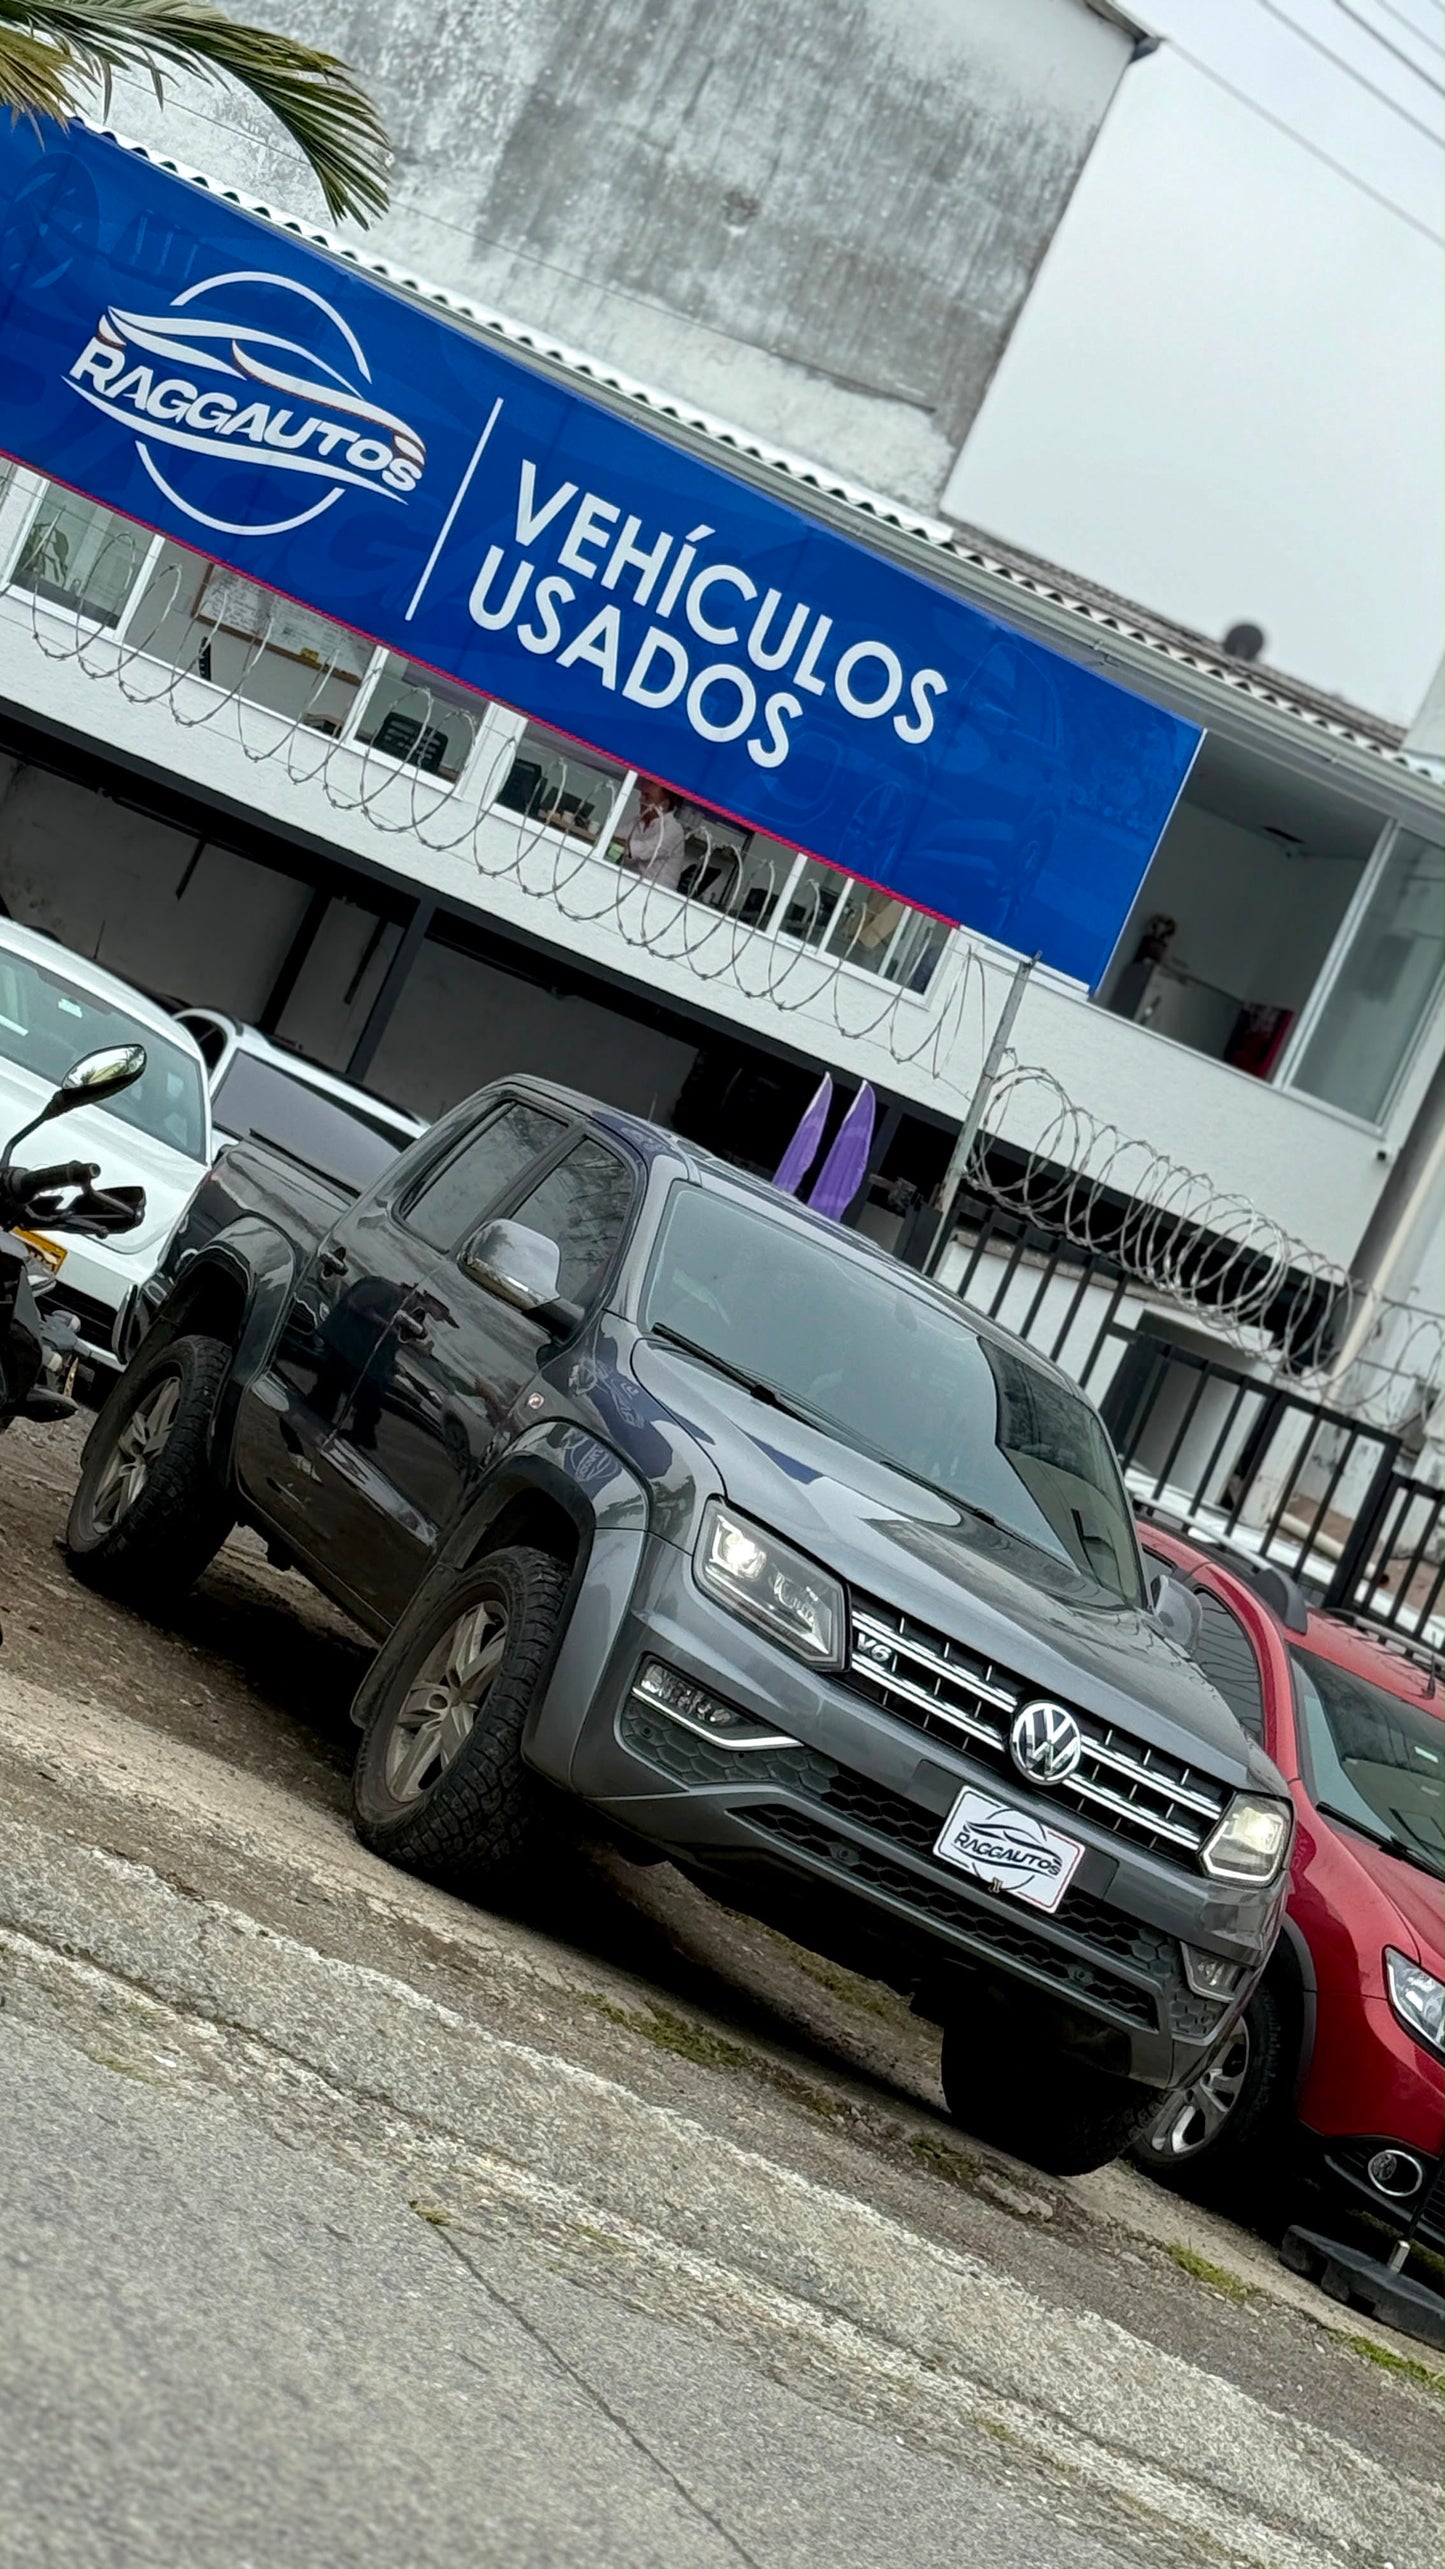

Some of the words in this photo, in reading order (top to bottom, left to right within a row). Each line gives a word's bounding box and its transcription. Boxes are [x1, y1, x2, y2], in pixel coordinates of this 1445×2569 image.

[69, 336, 423, 491] RAGGAUTOS
[470, 546, 802, 767] USADOS
[516, 460, 947, 743] VEHÍCULOS
[857, 1632, 892, 1662] V6
[954, 1832, 1061, 1876] RAGGAUTOS
